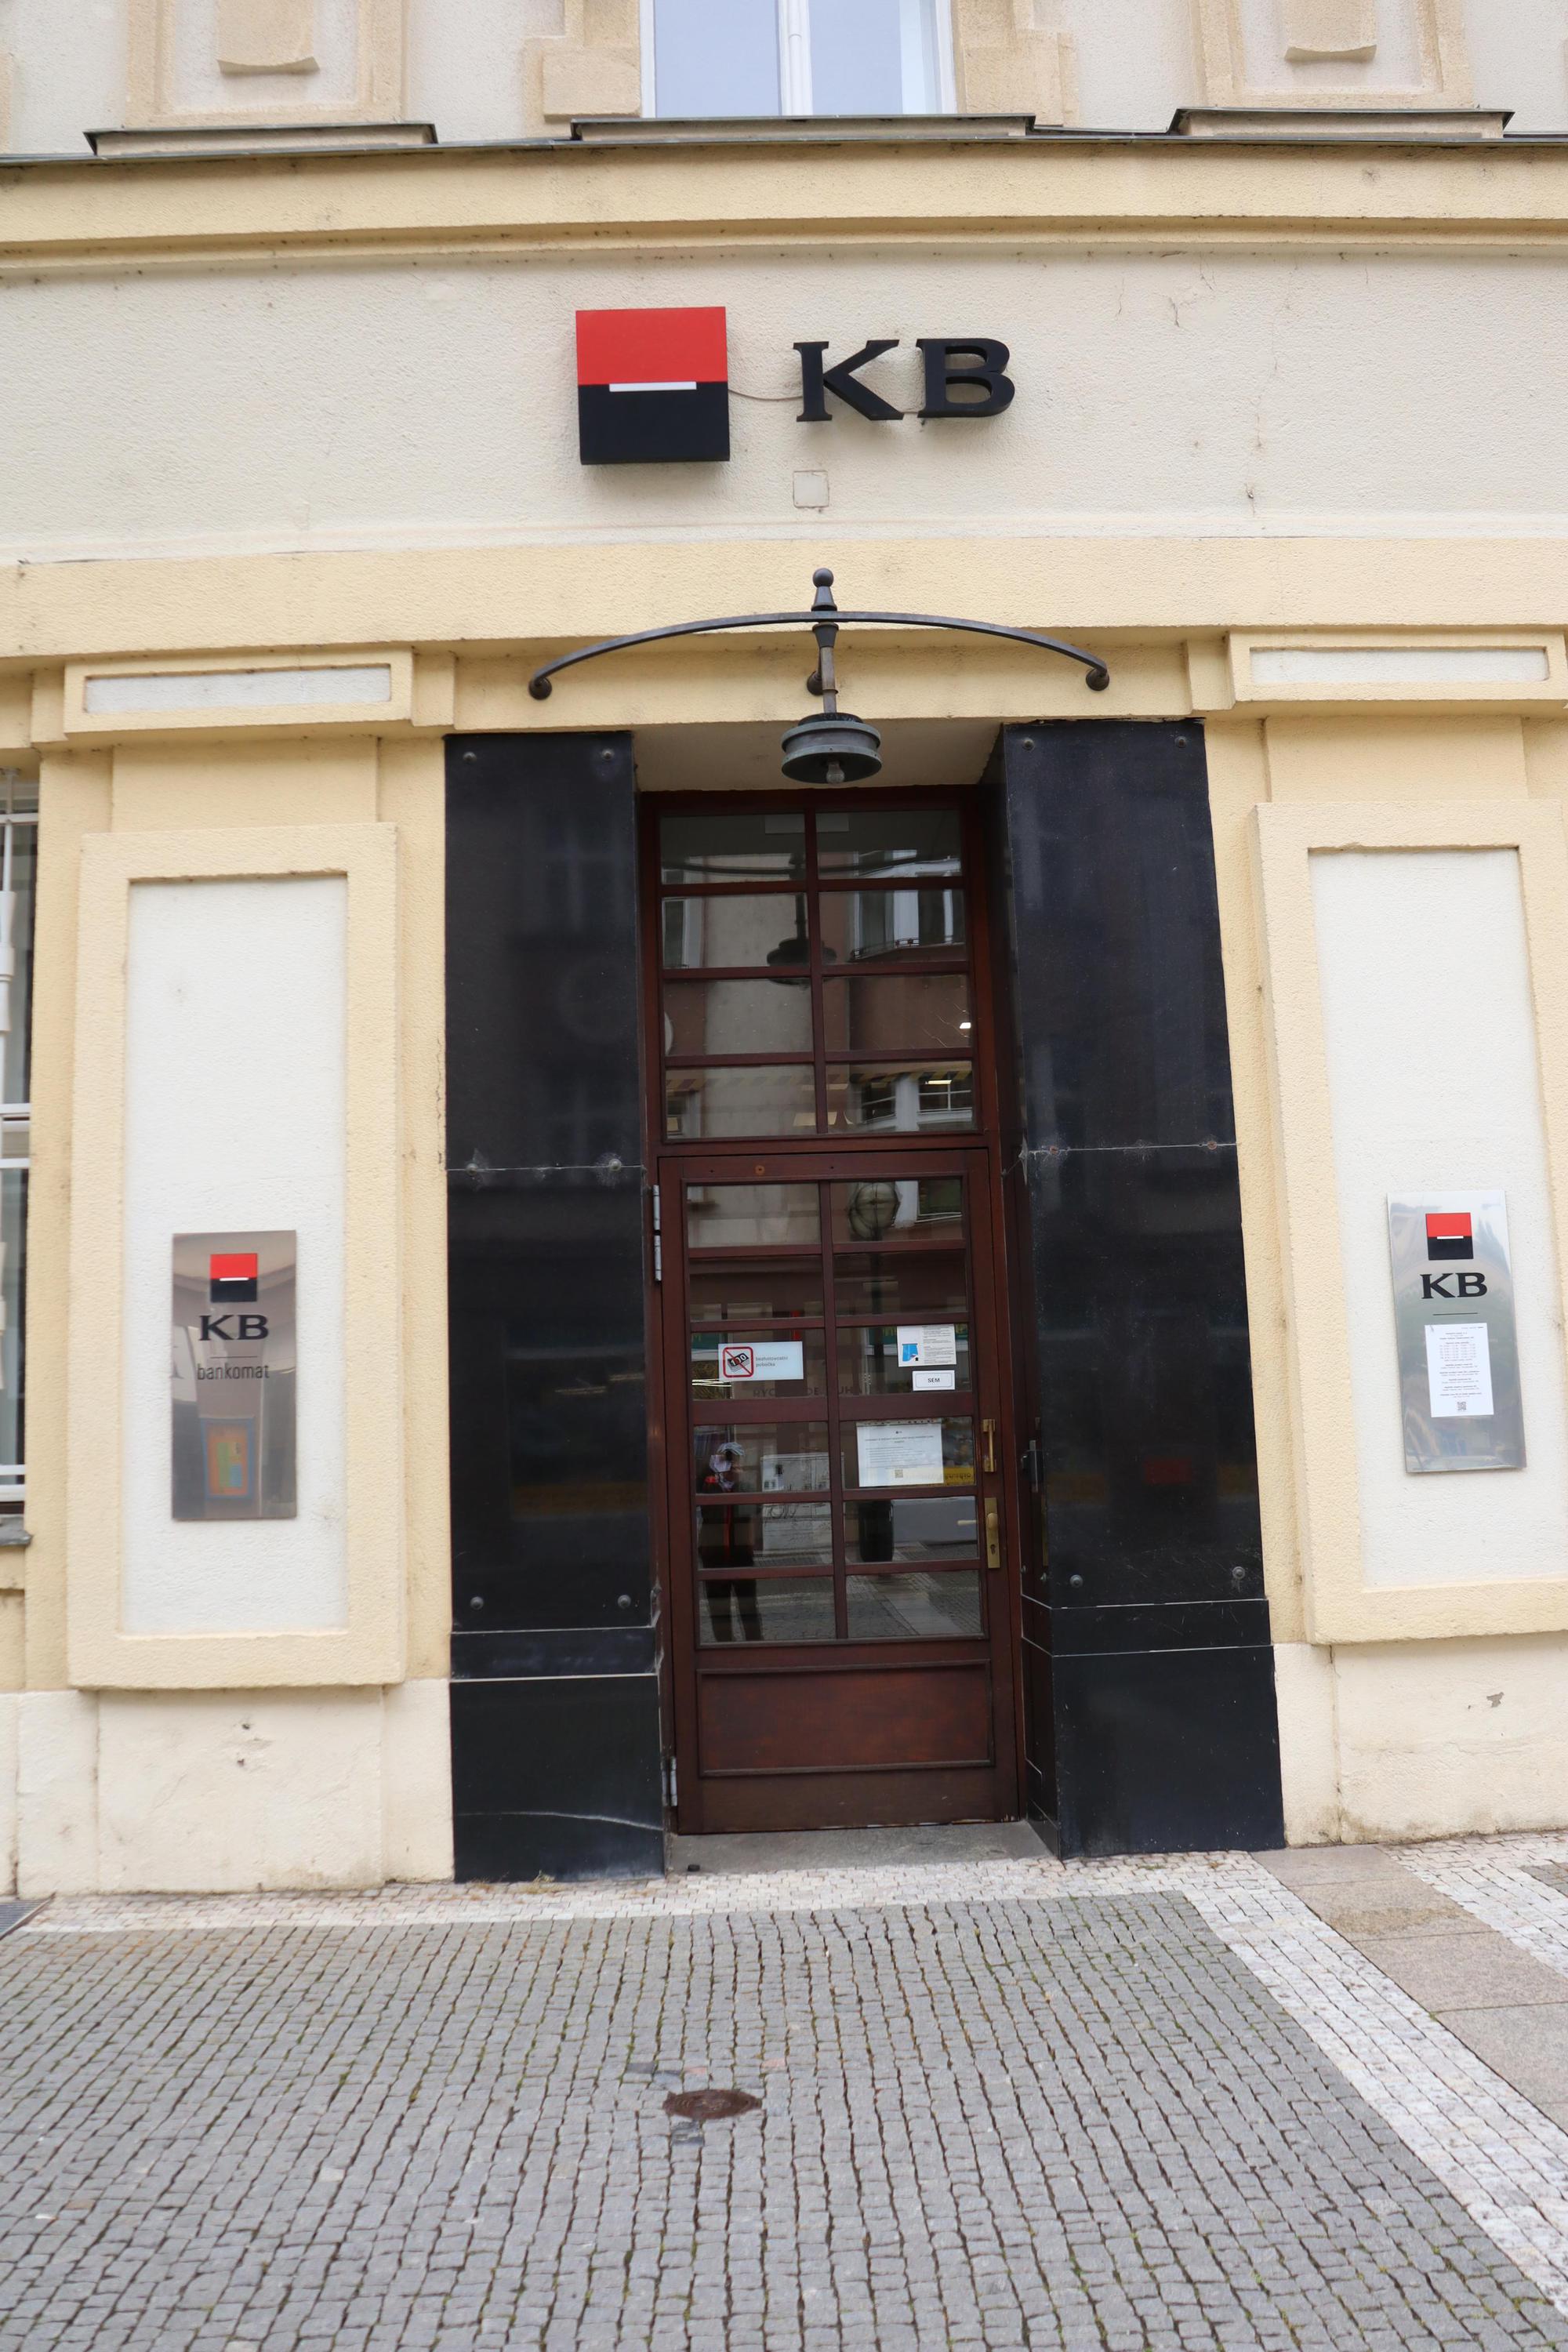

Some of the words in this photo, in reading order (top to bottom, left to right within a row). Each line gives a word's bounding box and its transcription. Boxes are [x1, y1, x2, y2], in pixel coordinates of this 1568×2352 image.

[793, 338, 1015, 423] KB
[1420, 1272, 1488, 1299] KB
[198, 1314, 270, 1341] KB
[197, 1363, 270, 1380] bankomat
